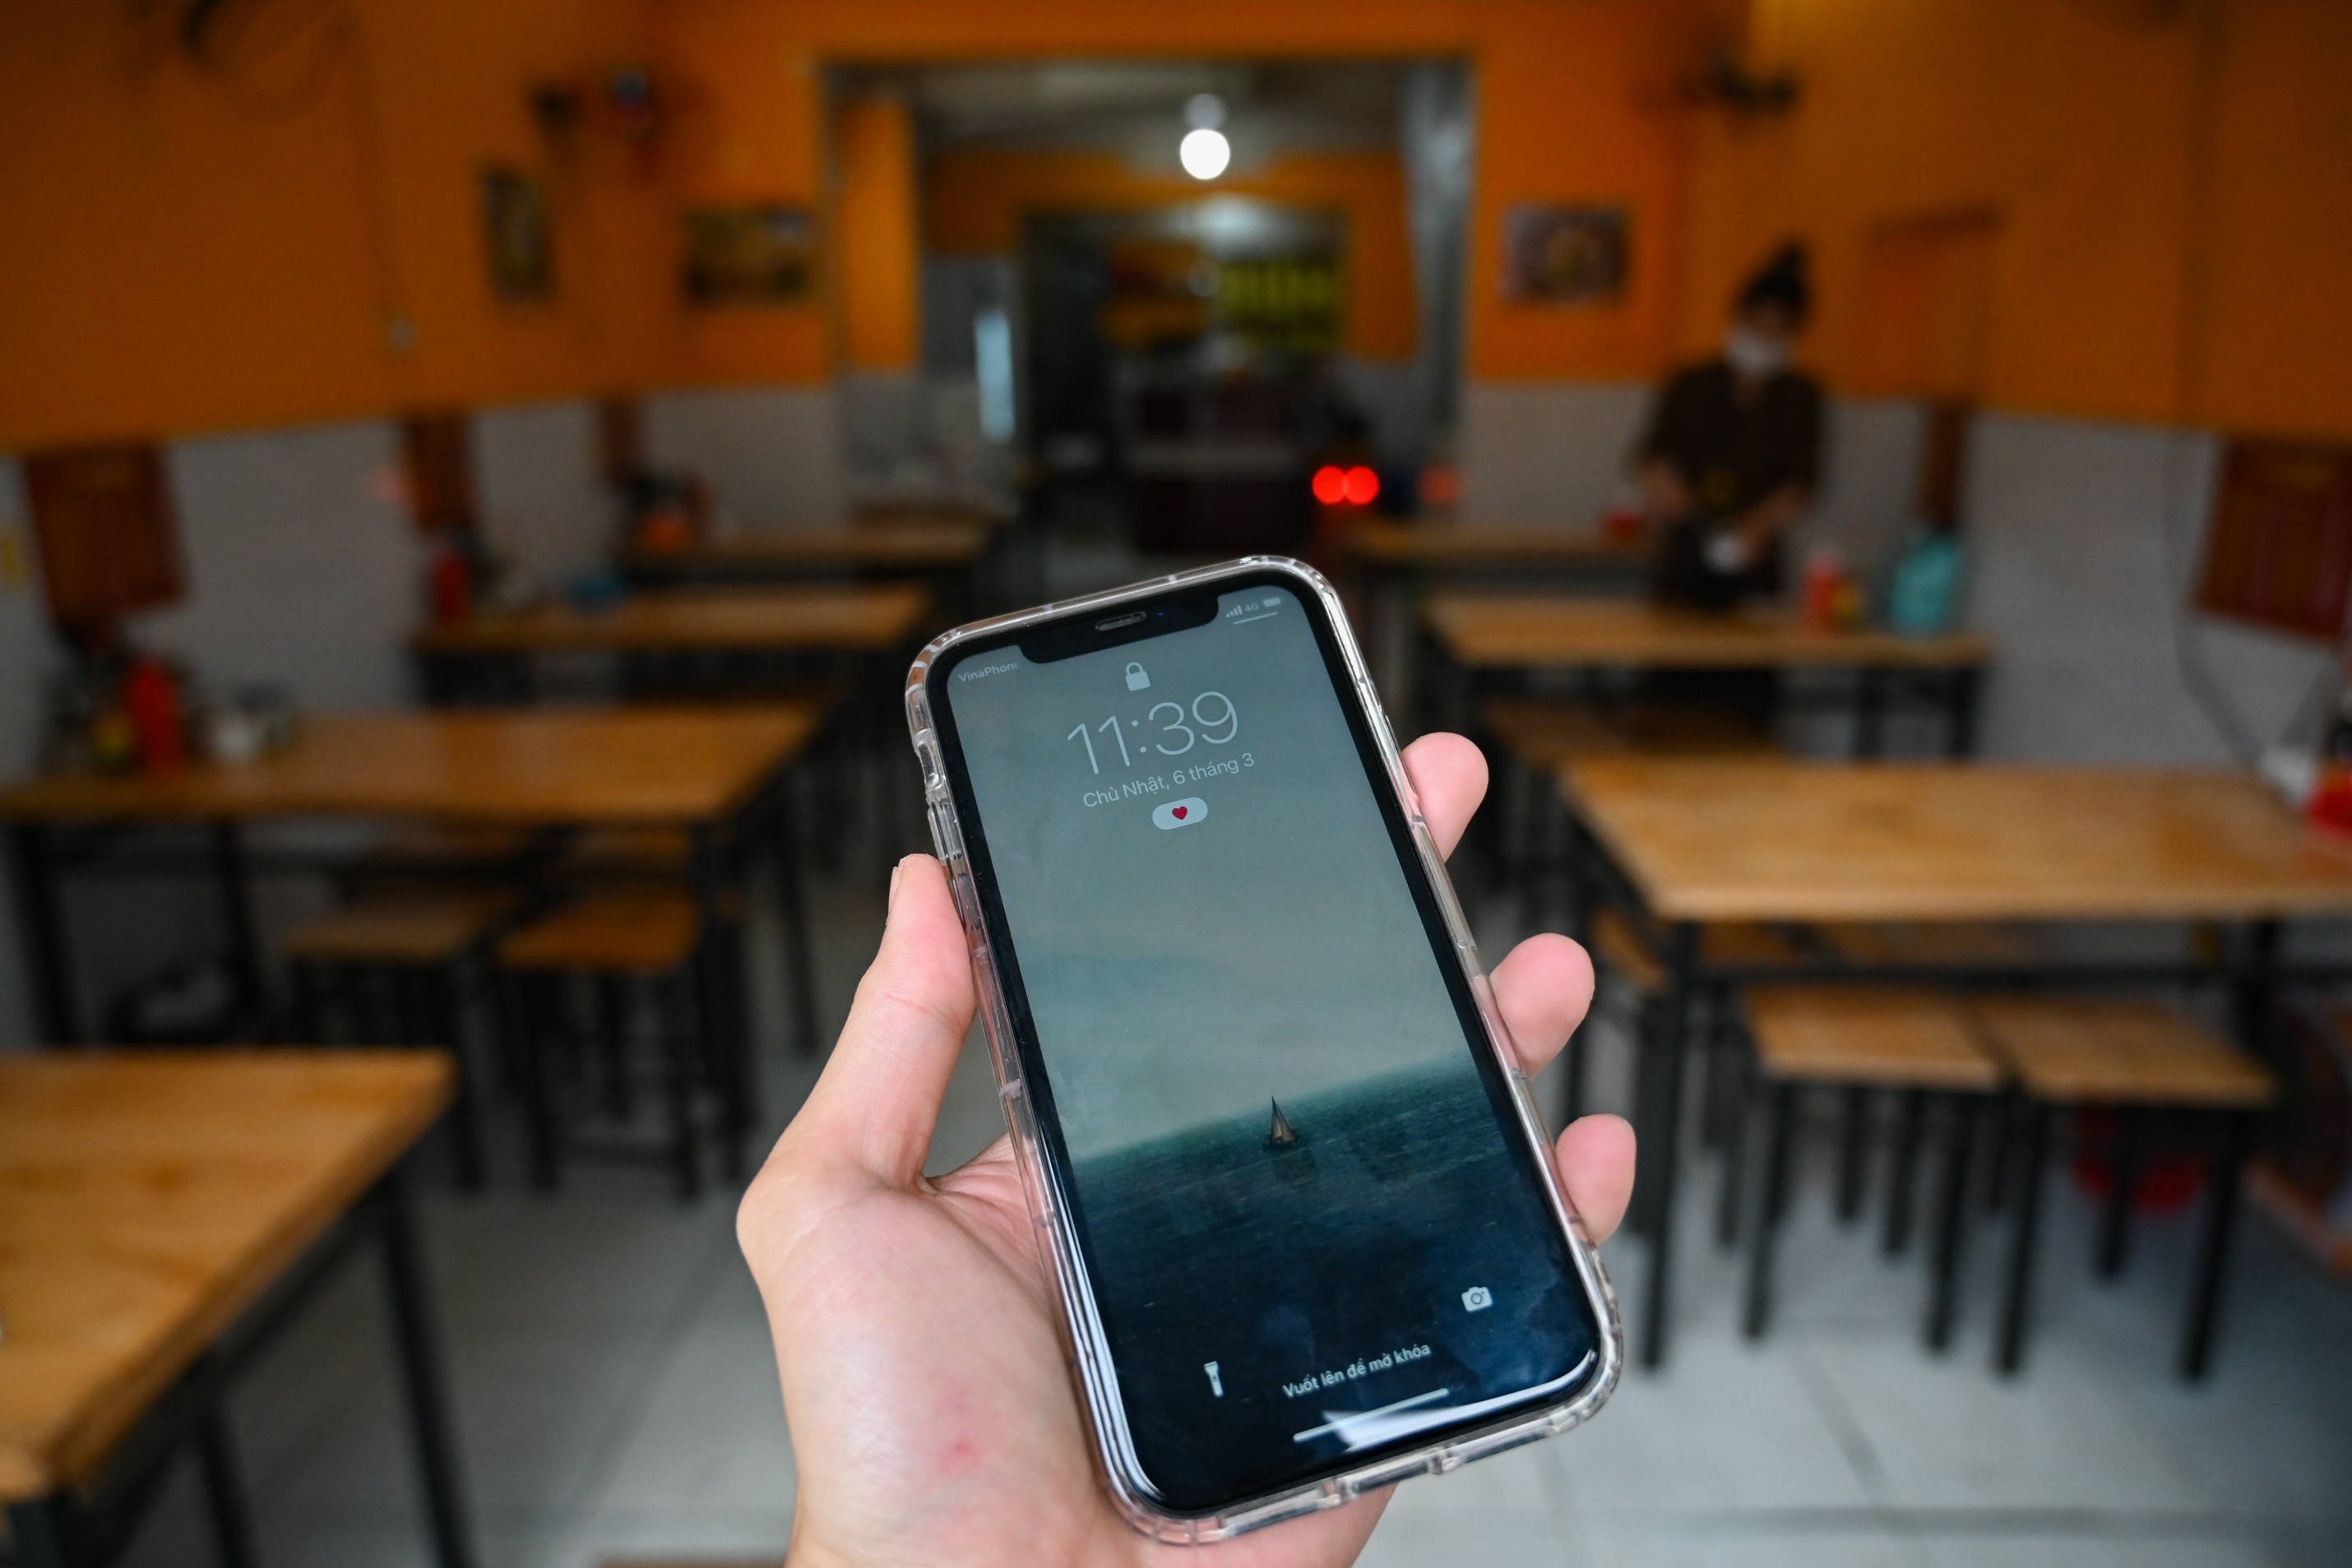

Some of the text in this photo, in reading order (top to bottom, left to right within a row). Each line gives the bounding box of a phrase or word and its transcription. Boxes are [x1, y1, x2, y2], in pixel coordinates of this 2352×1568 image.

[1245, 603, 1259, 612] 4G
[1067, 691, 1239, 775] 11:39
[1083, 752, 1255, 807] Chủ Nhật, 6 tháng 3
[1282, 1373, 1320, 1398] Vuốt
[1320, 1370, 1346, 1386] lên
[1393, 1343, 1432, 1364] khóa
